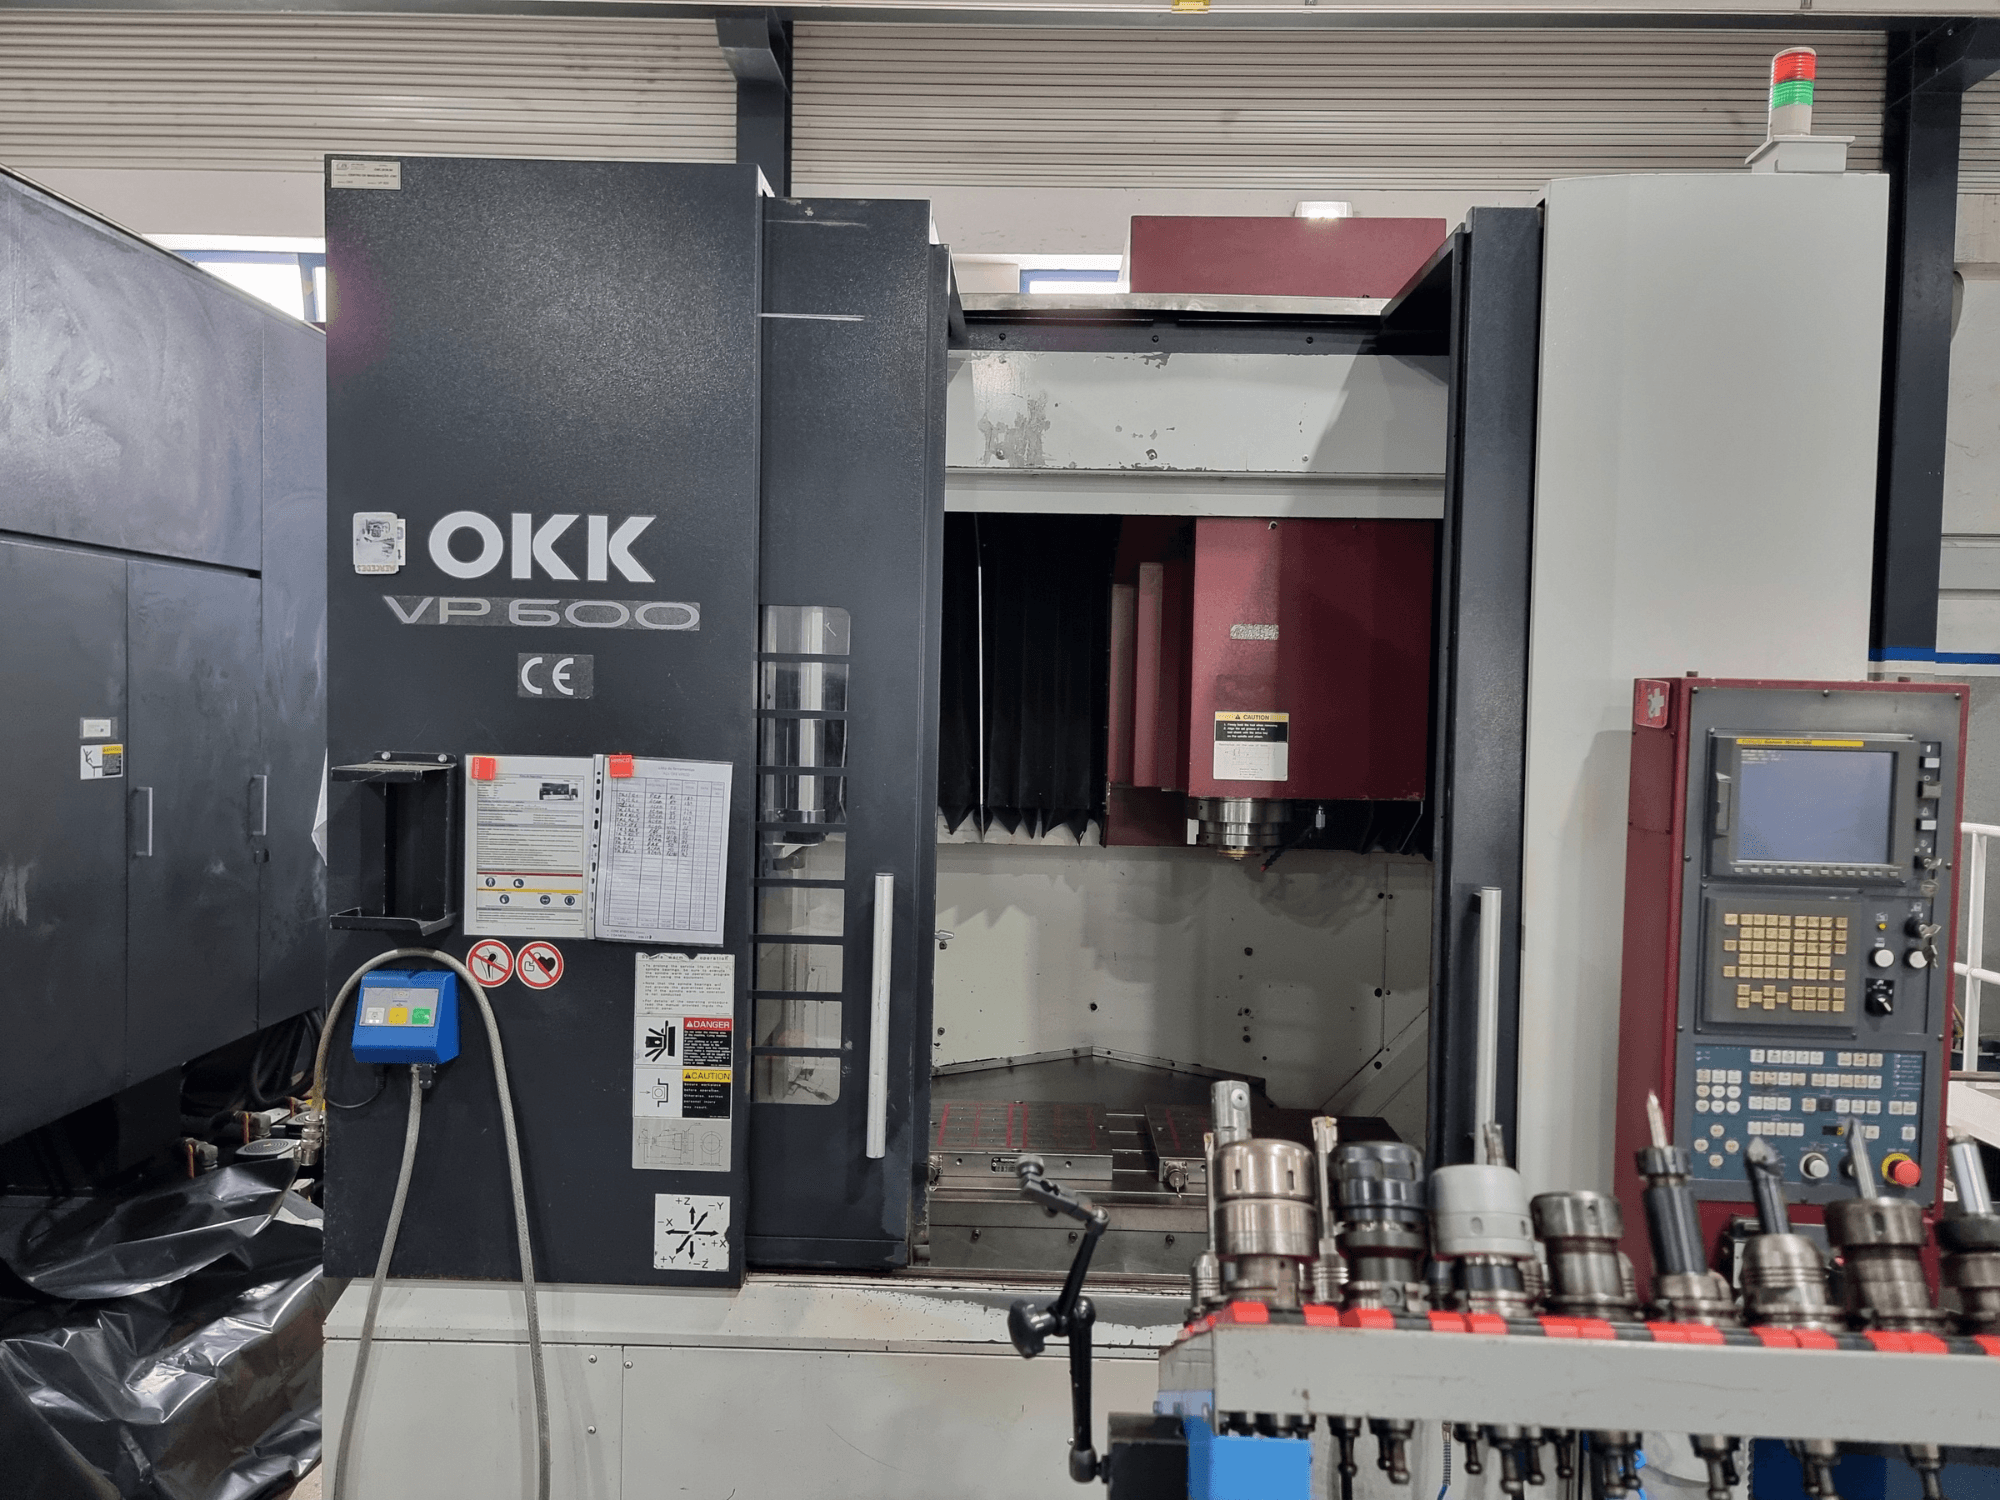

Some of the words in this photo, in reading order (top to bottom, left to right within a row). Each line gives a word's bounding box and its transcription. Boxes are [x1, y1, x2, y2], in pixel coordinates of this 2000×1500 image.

[428, 510, 656, 583] OKK
[383, 596, 491, 625] VP
[508, 599, 700, 631] 600
[521, 657, 574, 696] CE
[693, 1020, 730, 1028] DANGER
[691, 1071, 730, 1080] CAUTION
[675, 1196, 691, 1206] +Z
[711, 1239, 727, 1248] +X
[660, 1255, 676, 1264] +Y
